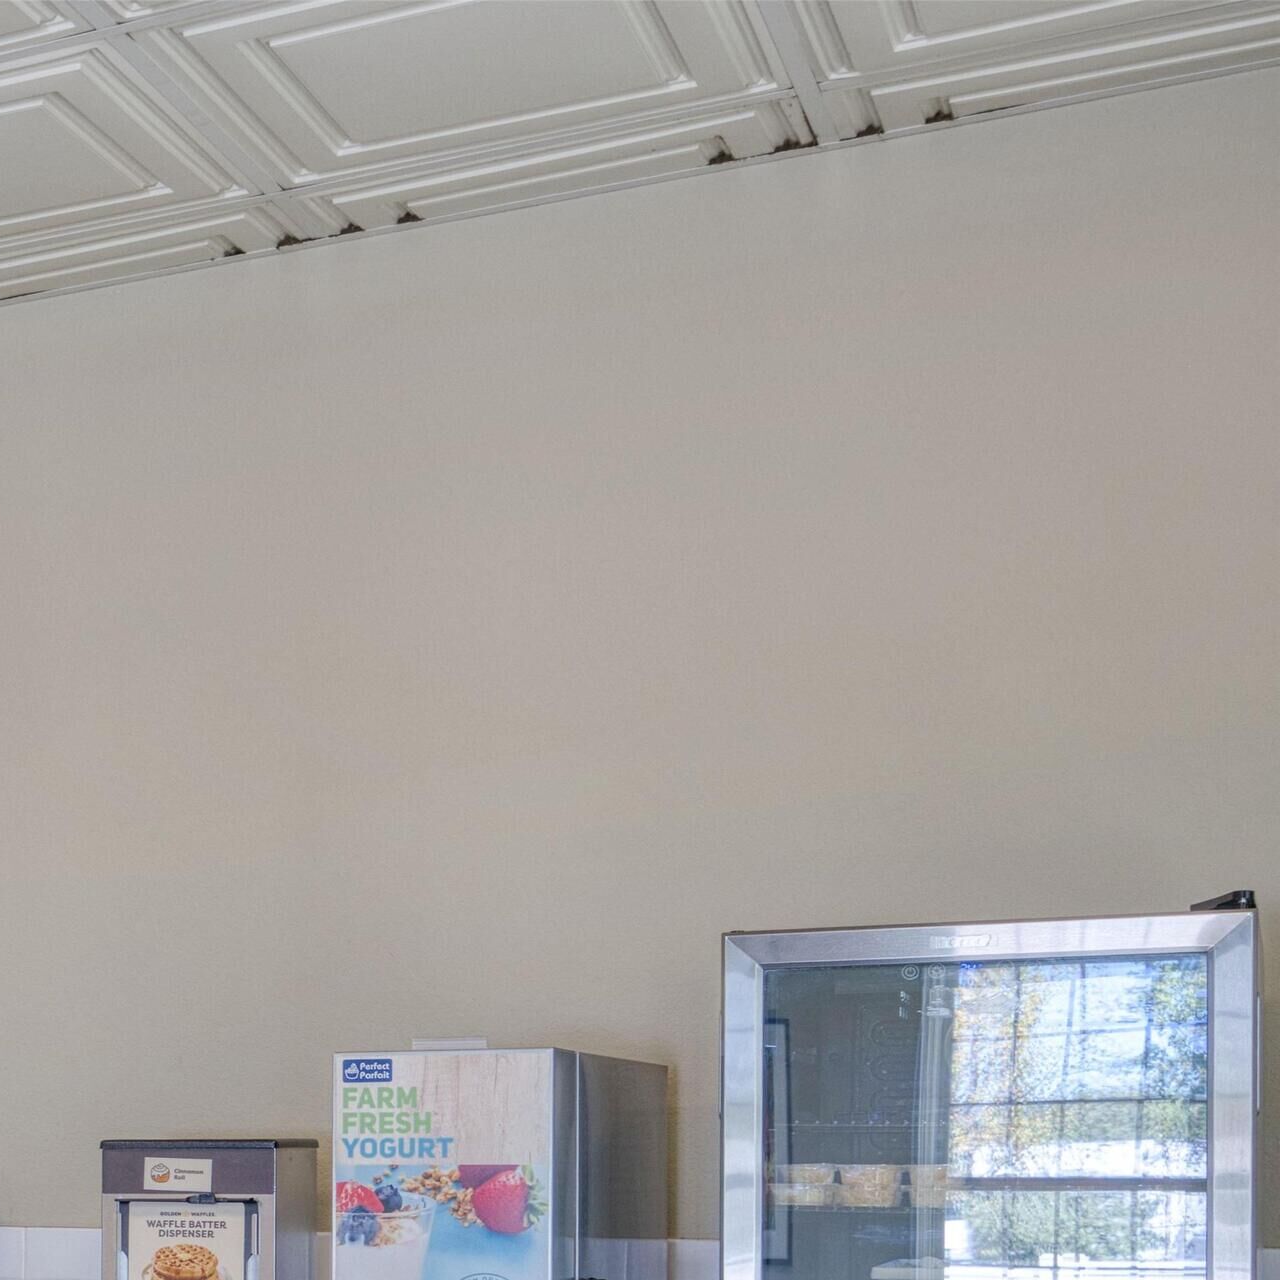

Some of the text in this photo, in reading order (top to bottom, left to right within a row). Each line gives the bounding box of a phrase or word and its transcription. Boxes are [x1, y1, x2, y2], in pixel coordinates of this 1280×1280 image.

[359, 1062, 390, 1070] Perfect
[359, 1070, 390, 1079] Parfait
[342, 1086, 418, 1109] FARM
[342, 1111, 432, 1134] FRESH
[341, 1137, 454, 1159] YOGURT
[146, 1220, 227, 1229] WAFFLE BATTER
[158, 1229, 215, 1238] DISPENSER
